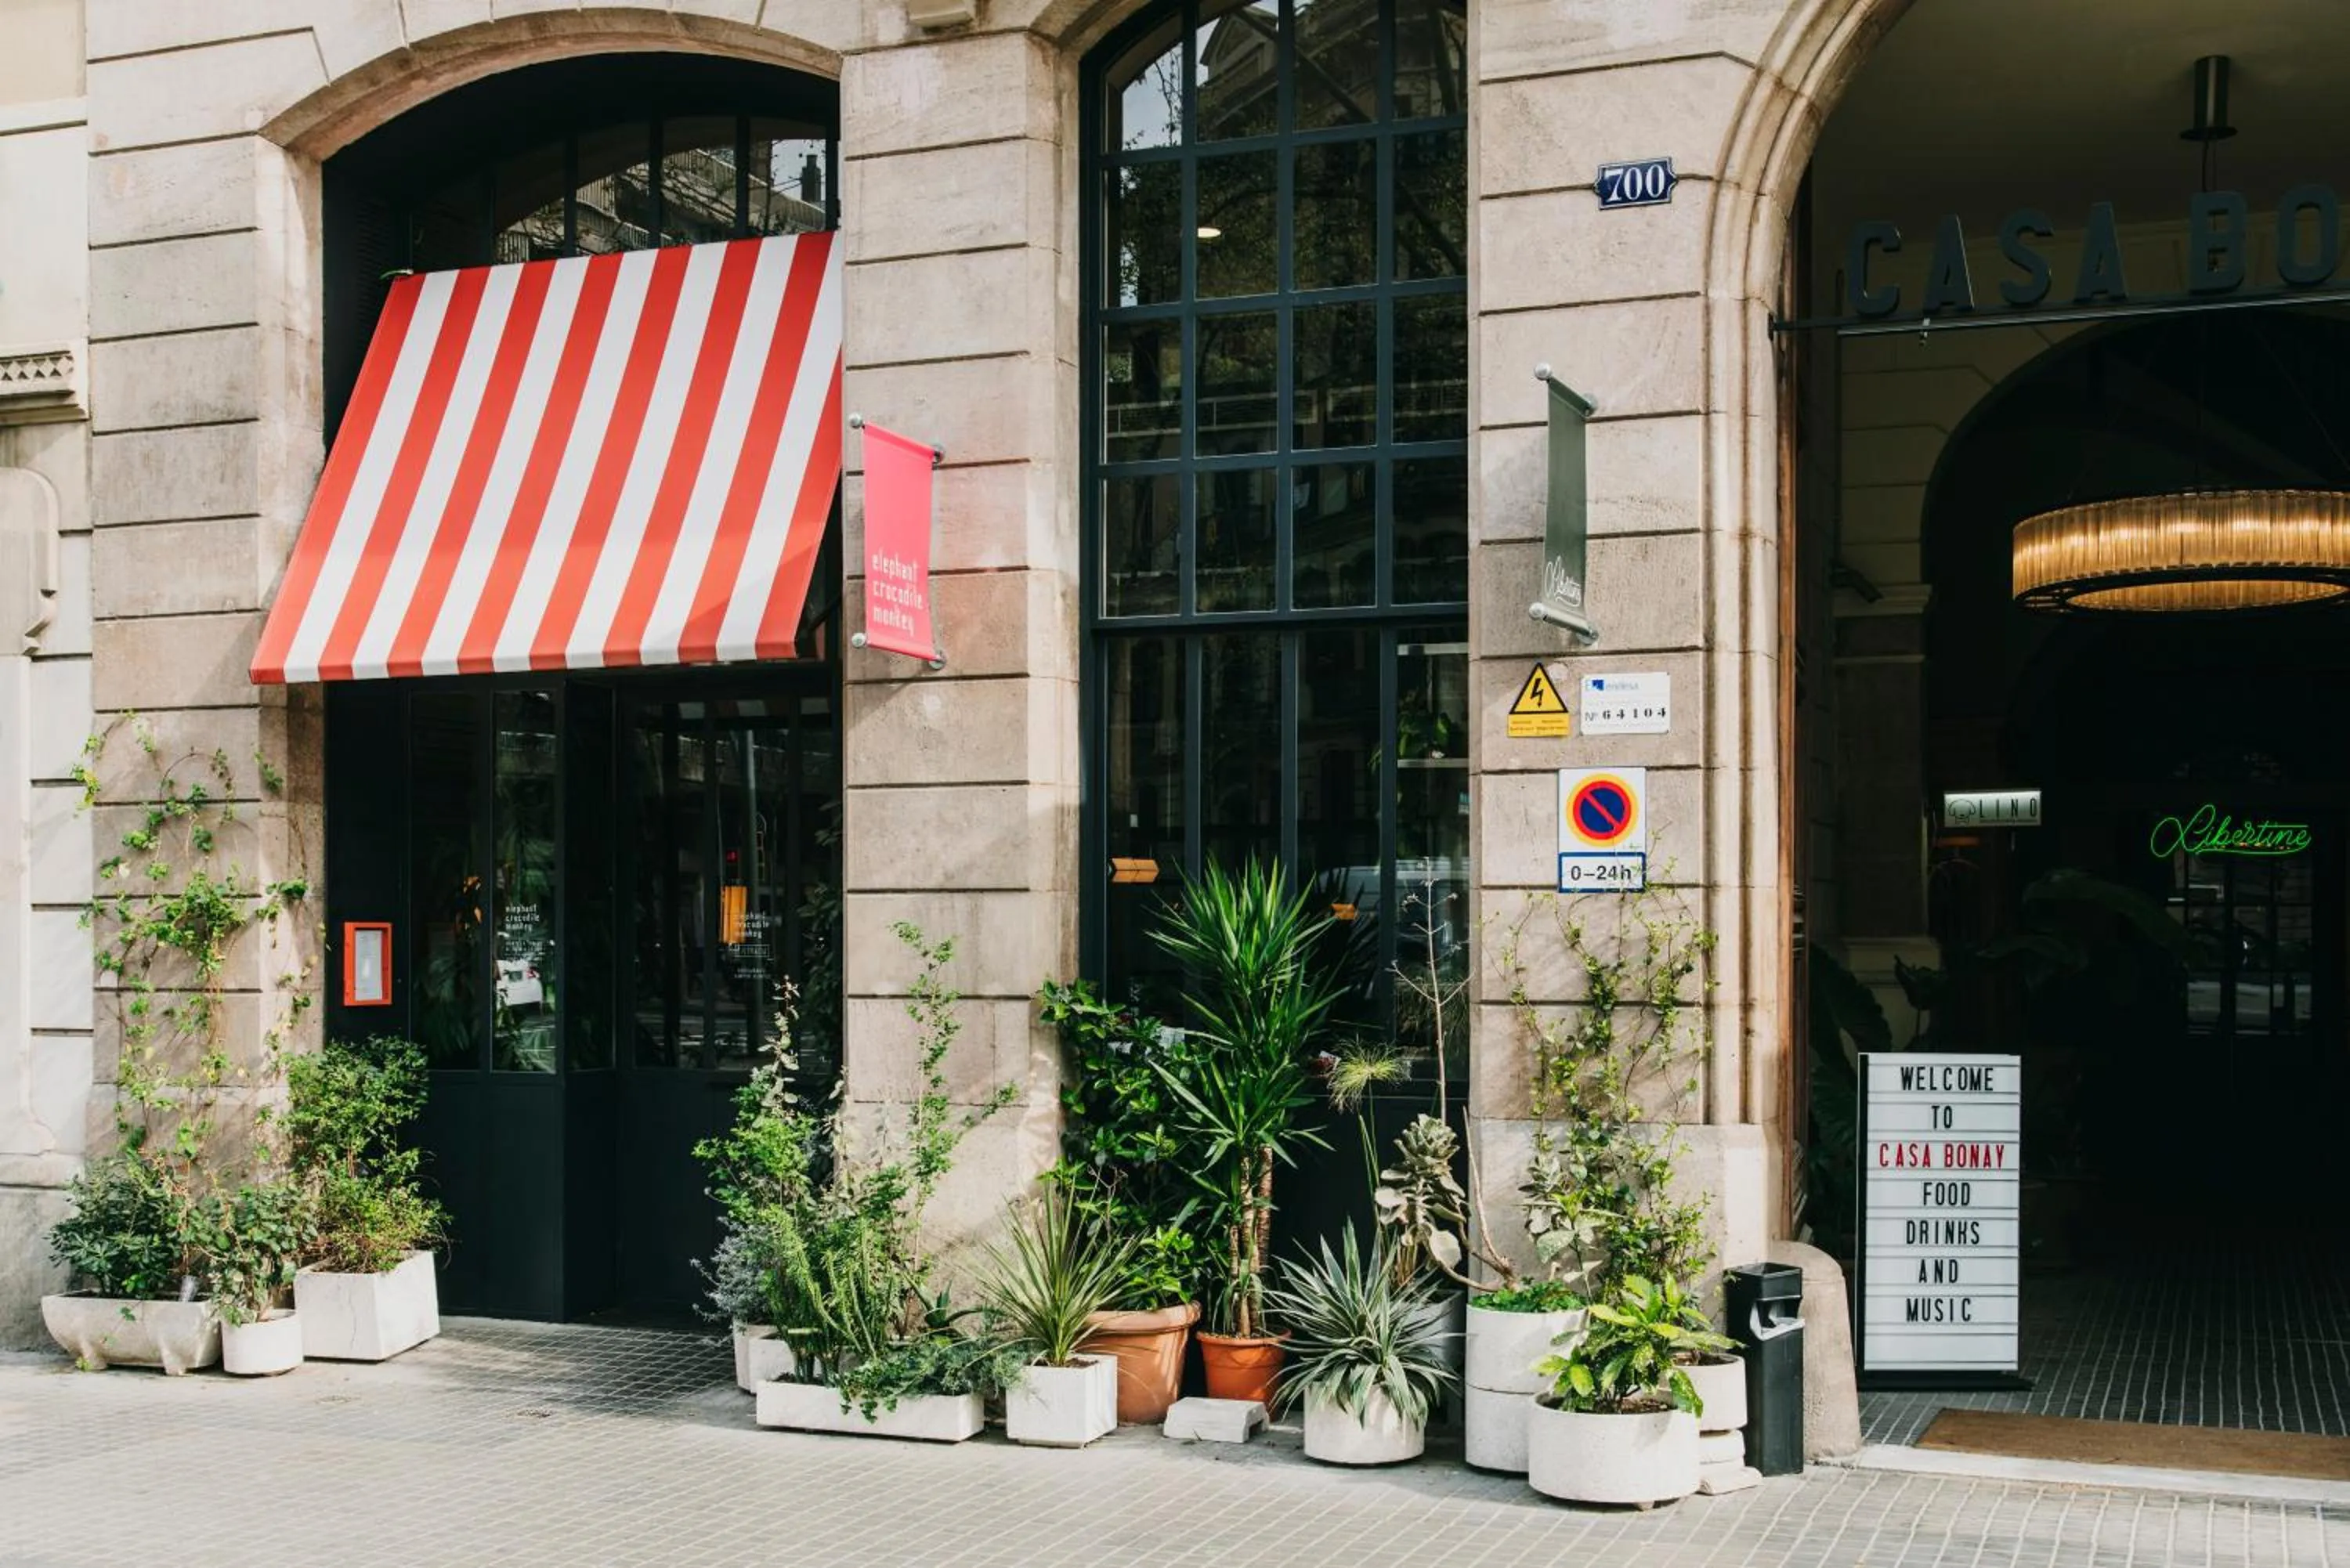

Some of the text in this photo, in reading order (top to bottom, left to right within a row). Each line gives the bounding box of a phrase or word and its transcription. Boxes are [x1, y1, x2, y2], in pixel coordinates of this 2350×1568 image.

[1603, 164, 1665, 202] 700
[1847, 201, 2129, 316] CASA
[872, 547, 917, 583] elephant
[873, 580, 924, 610] crocodile
[873, 605, 914, 638] monkey
[1979, 797, 2037, 818] LINO
[2150, 804, 2312, 858] Libertine
[1900, 1066, 1994, 1091] WELCOME
[1931, 1105, 1953, 1129] TO
[1879, 1143, 2005, 1169] CASA BONAY
[1922, 1182, 1971, 1206] FOOD
[1905, 1219, 1980, 1245] DRINKS
[1918, 1259, 1958, 1284] AND
[1906, 1297, 1972, 1322] MUSIC
